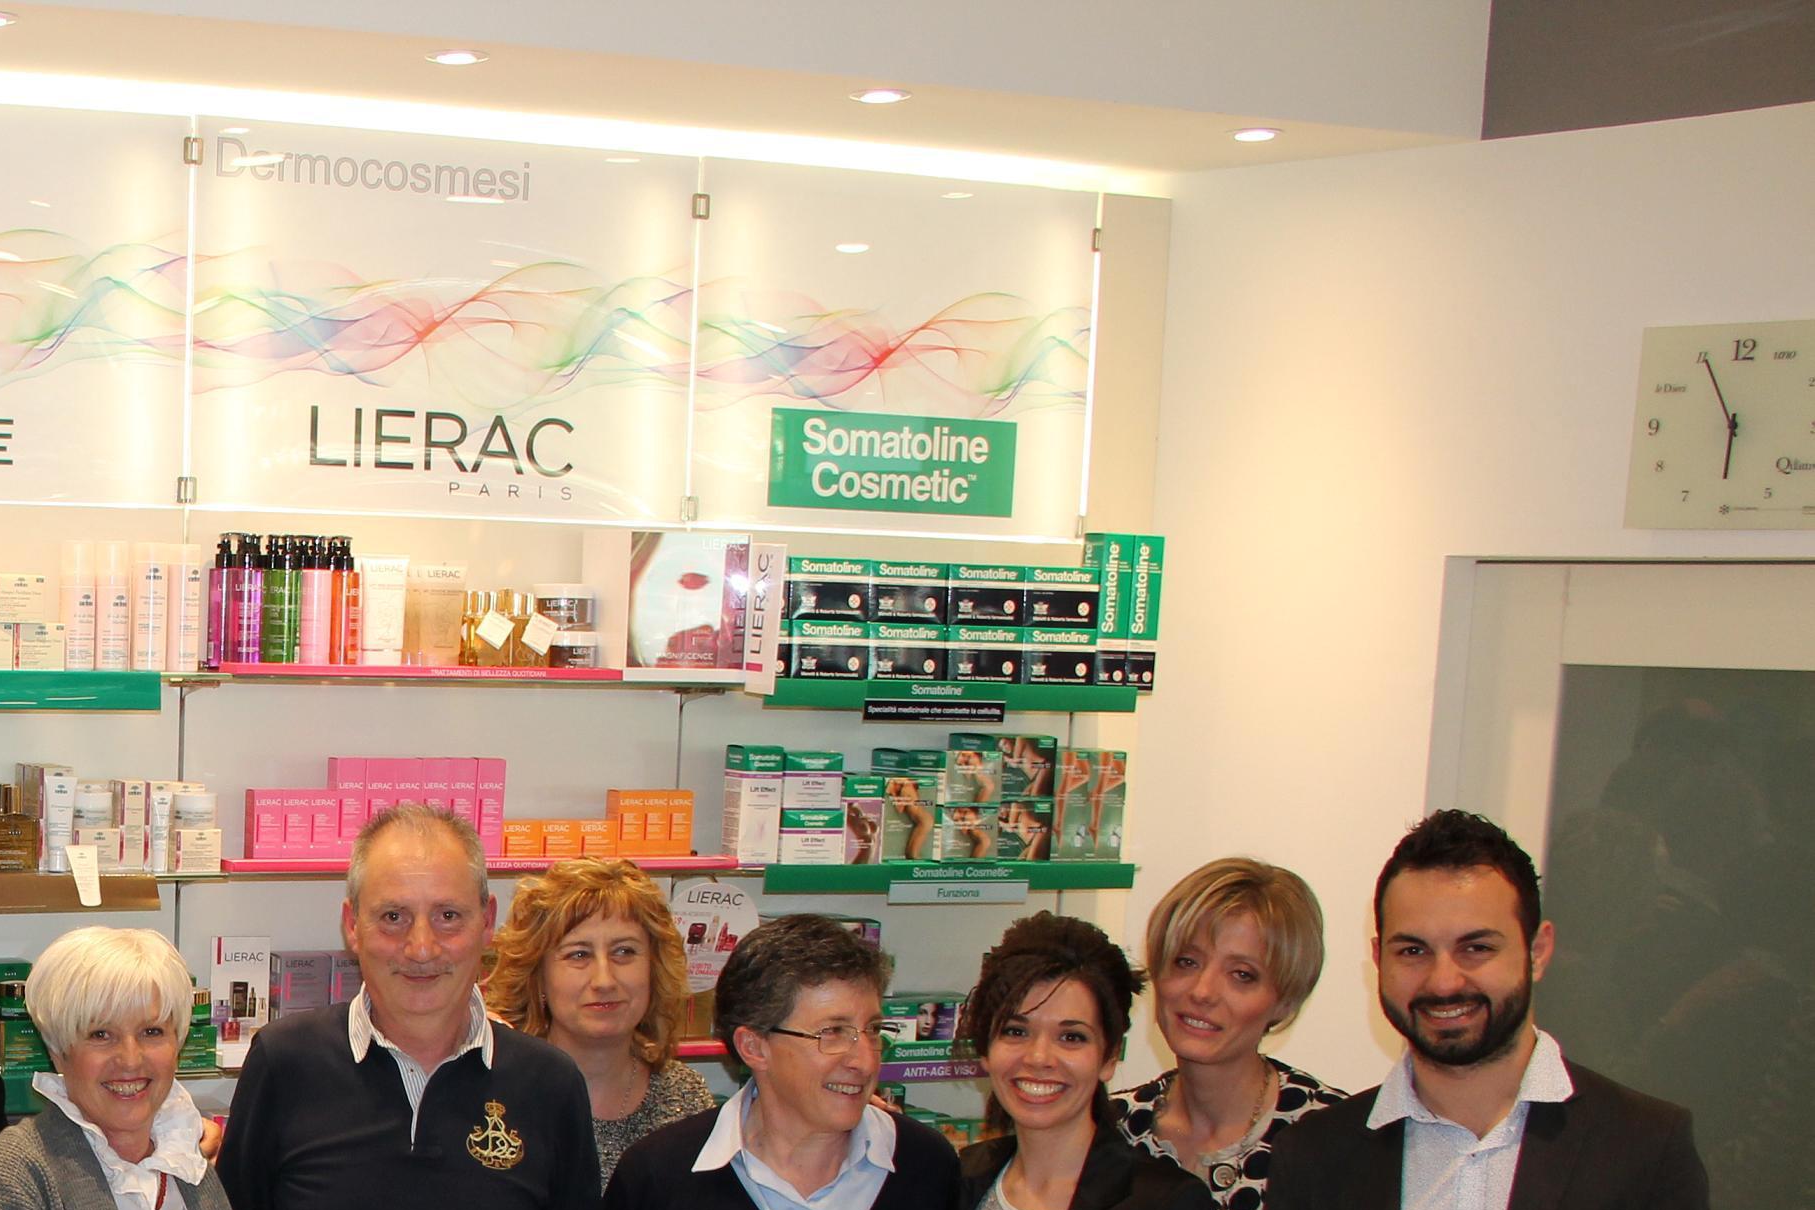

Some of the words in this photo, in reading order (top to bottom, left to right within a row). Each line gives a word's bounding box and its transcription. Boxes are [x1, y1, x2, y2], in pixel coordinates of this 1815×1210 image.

[215, 136, 532, 203] Dermocosmesi
[1731, 338, 1757, 362] 12
[1647, 418, 1661, 436] 9
[307, 404, 576, 479] LIERAC
[802, 417, 990, 465] Somatoline
[1655, 460, 1665, 473] 8
[447, 480, 574, 502] PARIS
[1681, 490, 1690, 502] 7
[1763, 487, 1773, 500] 5
[800, 560, 863, 574] Somatoline
[879, 563, 939, 578] Somatoline
[427, 569, 461, 579] LIERAC
[958, 566, 1018, 581] Somatoline
[1033, 569, 1092, 583] Somatoline
[1100, 542, 1121, 634] Somatoline
[1130, 544, 1151, 635] Somatoline
[801, 623, 863, 637] Somatoline
[878, 626, 938, 640] Somatoline
[958, 629, 1016, 642] Somatoline
[1031, 630, 1090, 644] Somatoline
[911, 684, 964, 696] Somatoline
[339, 782, 365, 790] LIERAC
[367, 782, 393, 790] LIERAC
[395, 782, 421, 790] LIERAC
[423, 782, 448, 790] LIERAC
[451, 782, 476, 790] LIERAC
[479, 782, 504, 790] LIERAC
[256, 799, 282, 807] LIERAC
[283, 799, 309, 807] LIERAC
[311, 799, 336, 807] LIERAC
[669, 799, 693, 807] LIERAC
[503, 824, 531, 833] LIERAC
[542, 824, 570, 833] LIERAC
[580, 824, 608, 832] LIERAC
[912, 867, 964, 878] Somatoline
[687, 890, 745, 906] LIERAC
[937, 888, 980, 898] Funziona
[224, 952, 265, 962] LIERAC
[285, 959, 315, 968] LIERAC
[895, 1047, 945, 1058] Somatoline
[903, 1066, 952, 1078] ANTI-AGE
[953, 1065, 978, 1076] VISO
